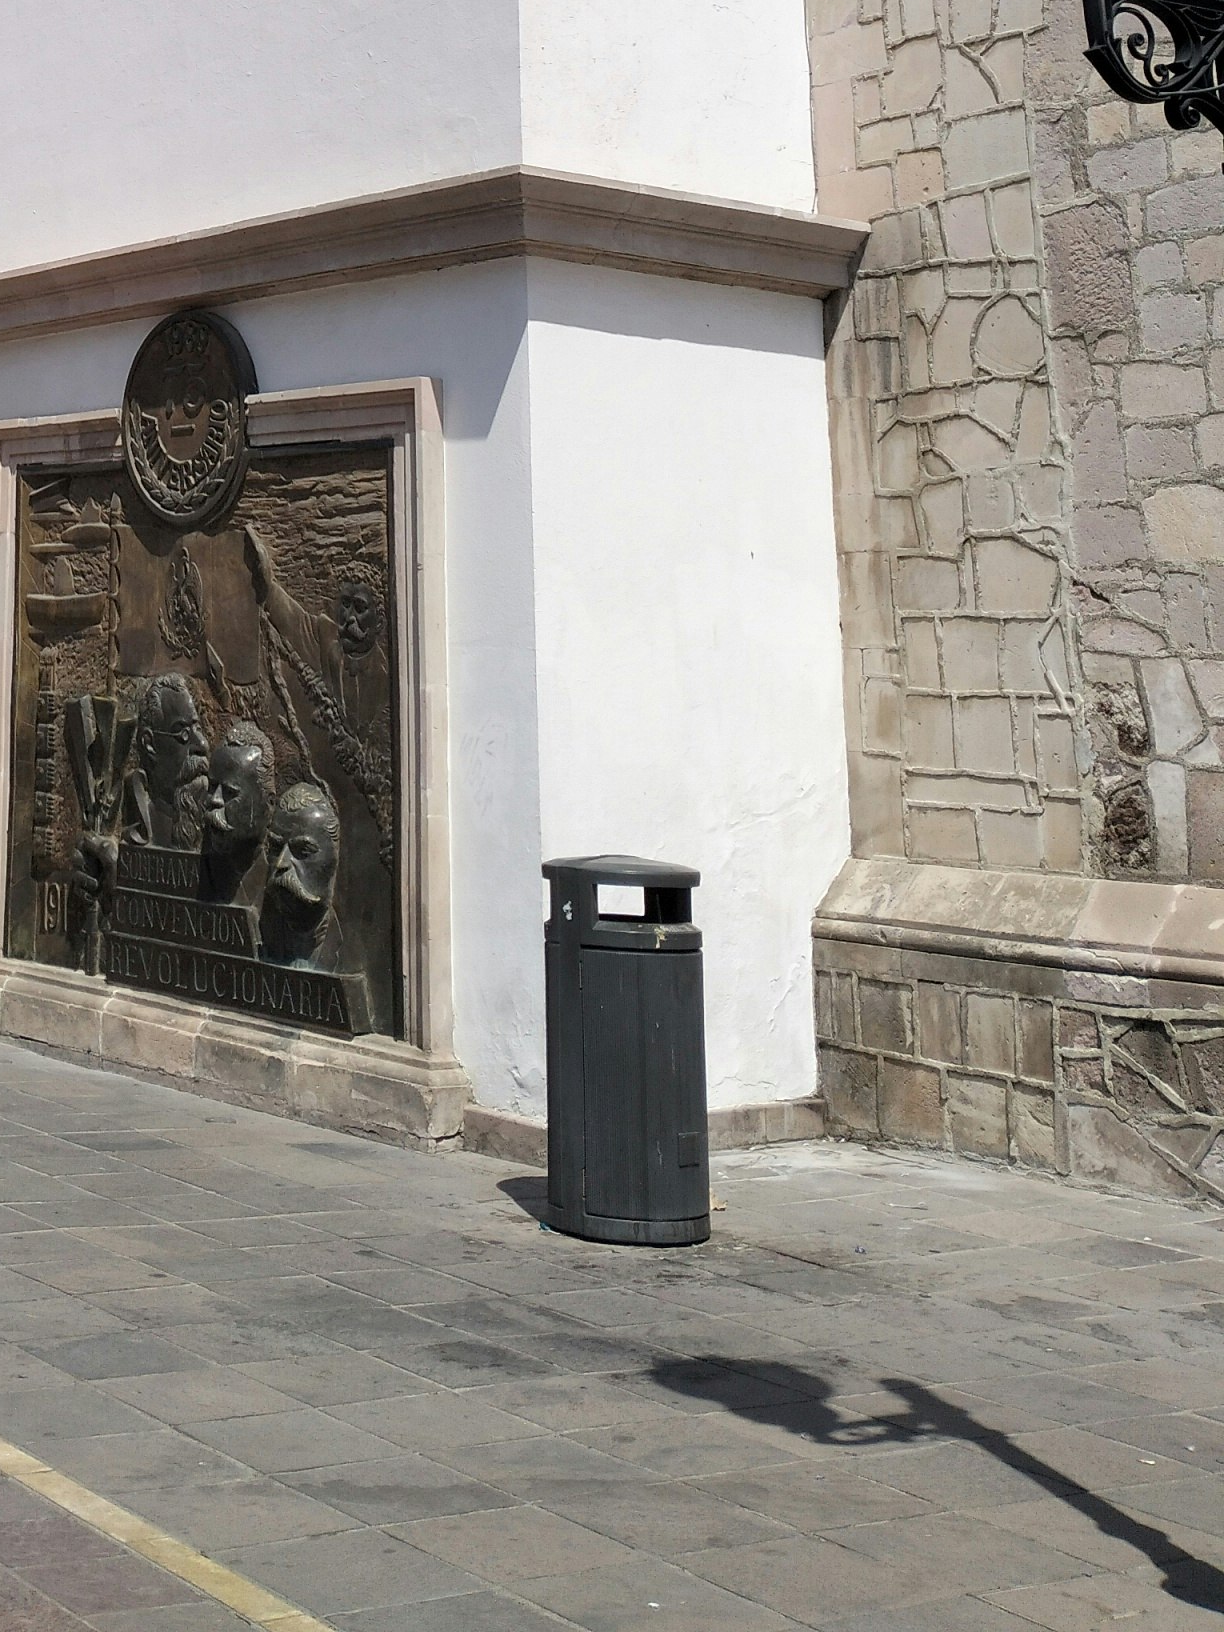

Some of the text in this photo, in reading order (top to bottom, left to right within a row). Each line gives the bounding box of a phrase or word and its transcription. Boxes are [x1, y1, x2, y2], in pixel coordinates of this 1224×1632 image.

[140, 398, 229, 495] ANIVERSARIO
[119, 851, 200, 889] SOBERANA
[114, 895, 246, 947] CONVENCION
[110, 939, 346, 1024] REVOLUCIONARIA
